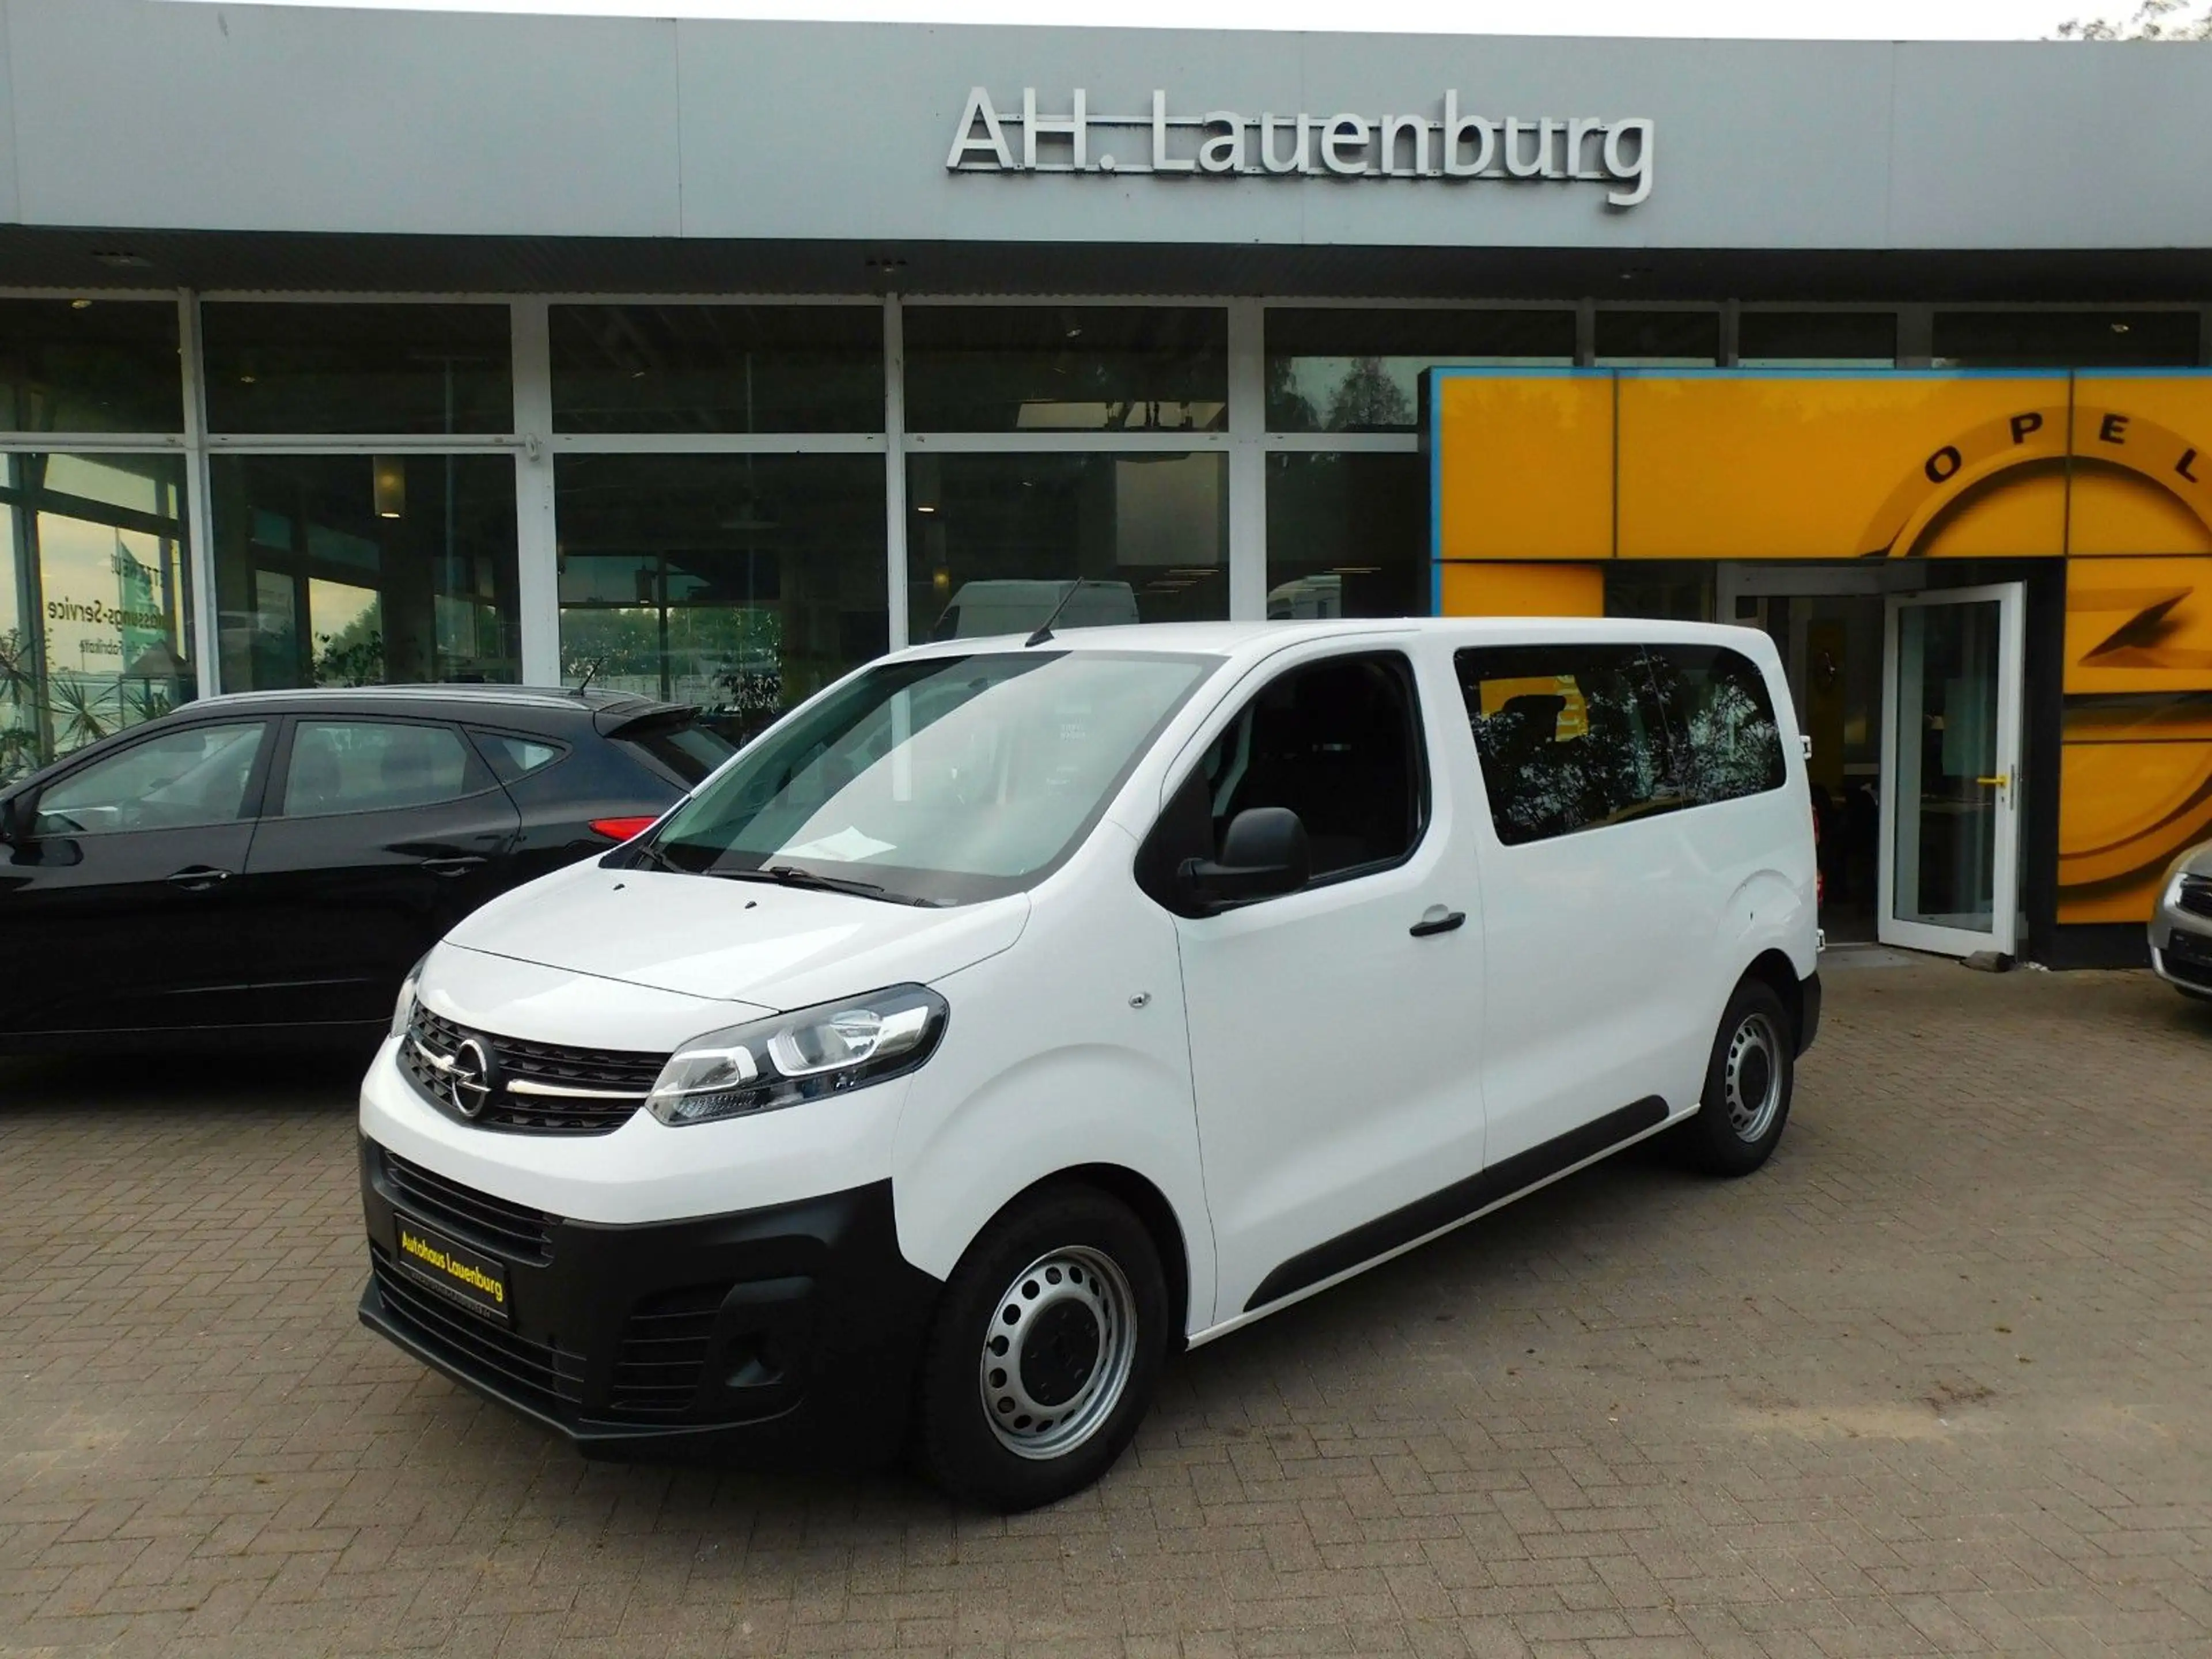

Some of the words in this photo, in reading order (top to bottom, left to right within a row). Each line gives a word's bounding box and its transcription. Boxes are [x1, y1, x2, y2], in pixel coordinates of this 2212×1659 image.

[945, 87, 1115, 172] AH.
[1153, 89, 1654, 206] Lauenburg
[1925, 412, 2199, 483] OPEL
[402, 1230, 446, 1270] Autohaus
[446, 1252, 503, 1303] Lauenburg
